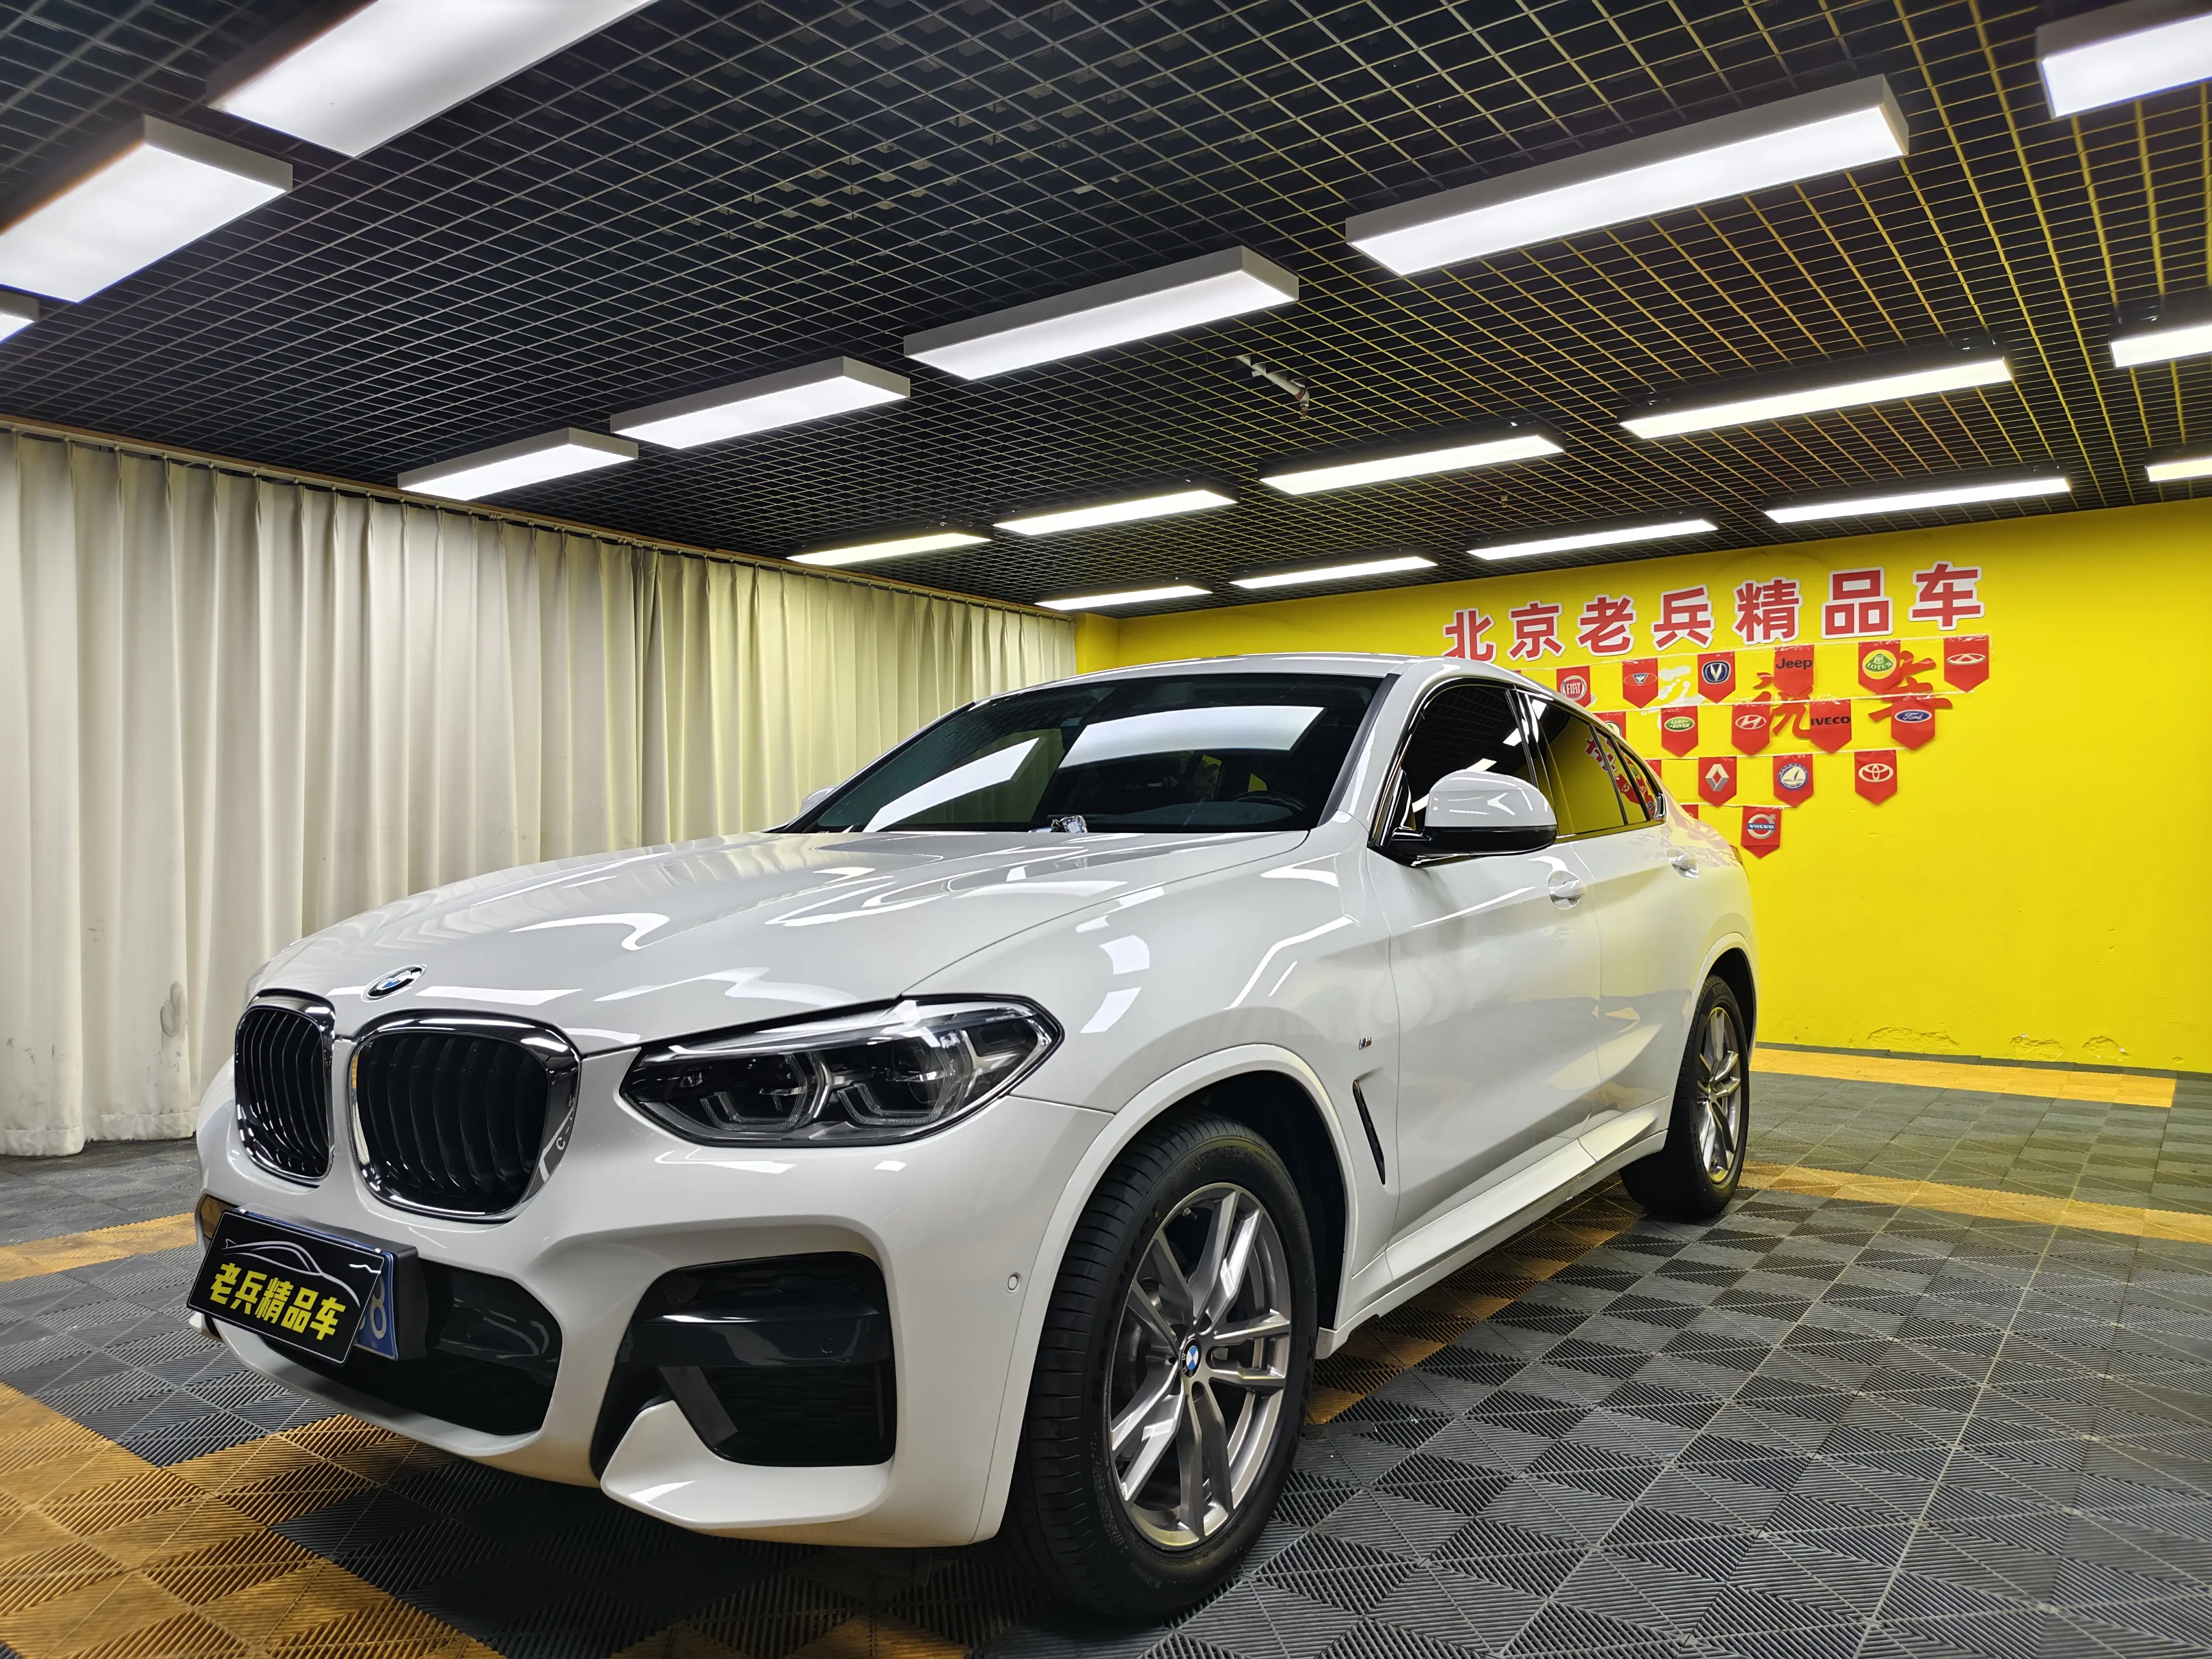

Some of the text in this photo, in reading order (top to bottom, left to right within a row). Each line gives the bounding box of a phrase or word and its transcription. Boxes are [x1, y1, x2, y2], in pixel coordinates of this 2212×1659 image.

[1443, 561, 1985, 662] 北京老兵精品车
[1776, 658, 1812, 670] Jeep
[1866, 662, 1892, 670] LOTUS
[1566, 682, 1581, 695] FIAT
[1811, 717, 1851, 725] IVECO
[210, 1262, 346, 1340] 老兵精品车
[1181, 1352, 1193, 1377] BMW
